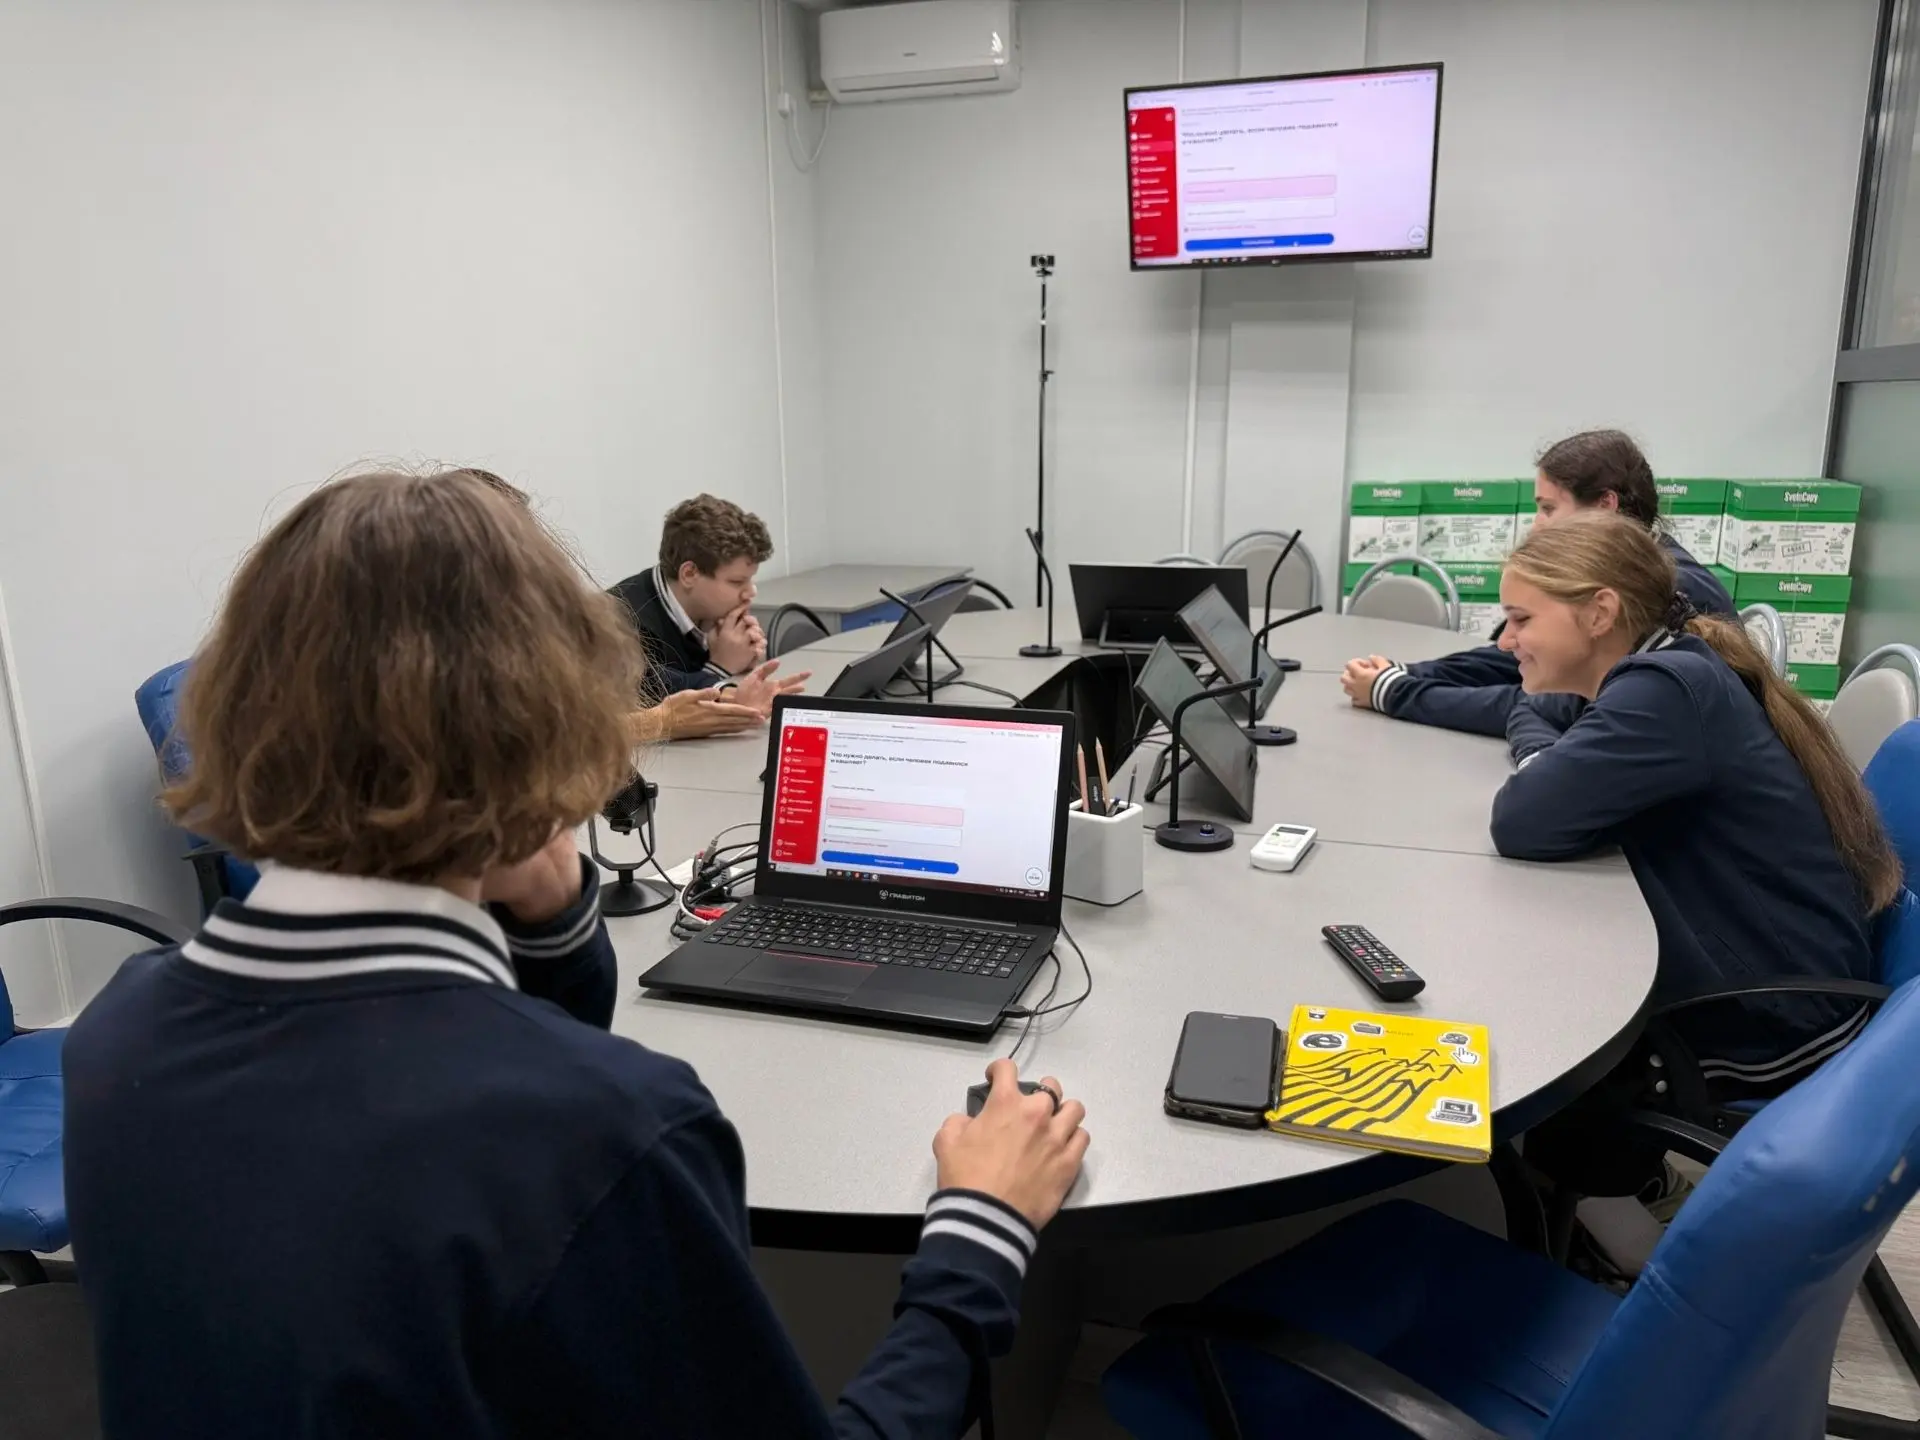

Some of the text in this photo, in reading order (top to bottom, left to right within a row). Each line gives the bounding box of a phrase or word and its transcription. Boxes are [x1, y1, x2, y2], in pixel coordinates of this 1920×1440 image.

[1784, 491, 1818, 504] SvetoCopy
[1778, 581, 1813, 593] SvetoCopy
[889, 892, 926, 901] ГРАВИТОН
